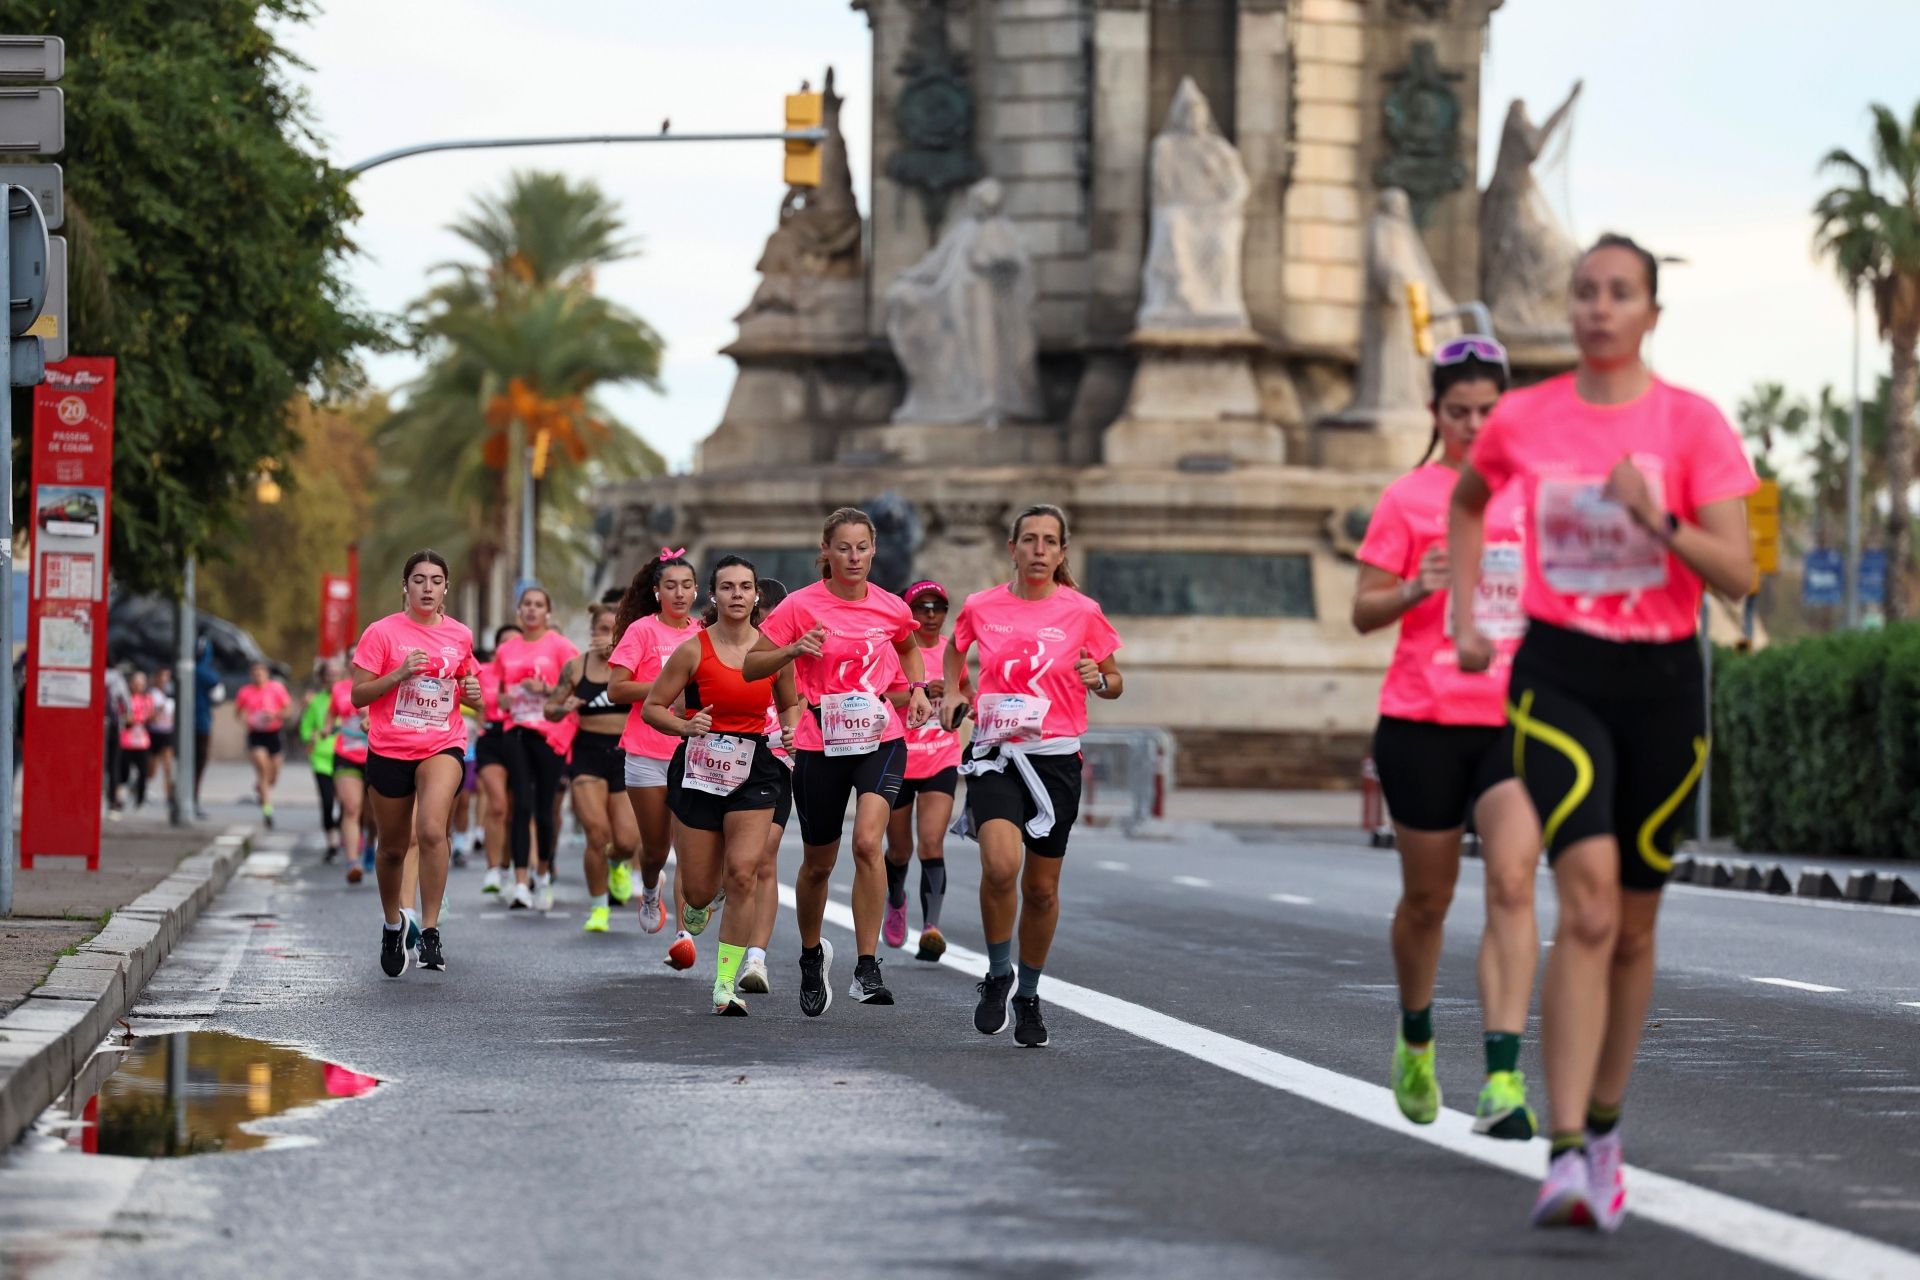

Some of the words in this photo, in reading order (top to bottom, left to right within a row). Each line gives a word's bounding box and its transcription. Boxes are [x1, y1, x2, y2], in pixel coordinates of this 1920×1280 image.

[64, 404, 82, 417] 20
[1480, 583, 1519, 599] 016
[821, 628, 844, 636] YSHO
[983, 623, 1013, 633] OYSHO
[417, 698, 438, 708] 016
[844, 718, 871, 729] 016
[995, 718, 1019, 729] 016
[706, 758, 731, 771] 016
